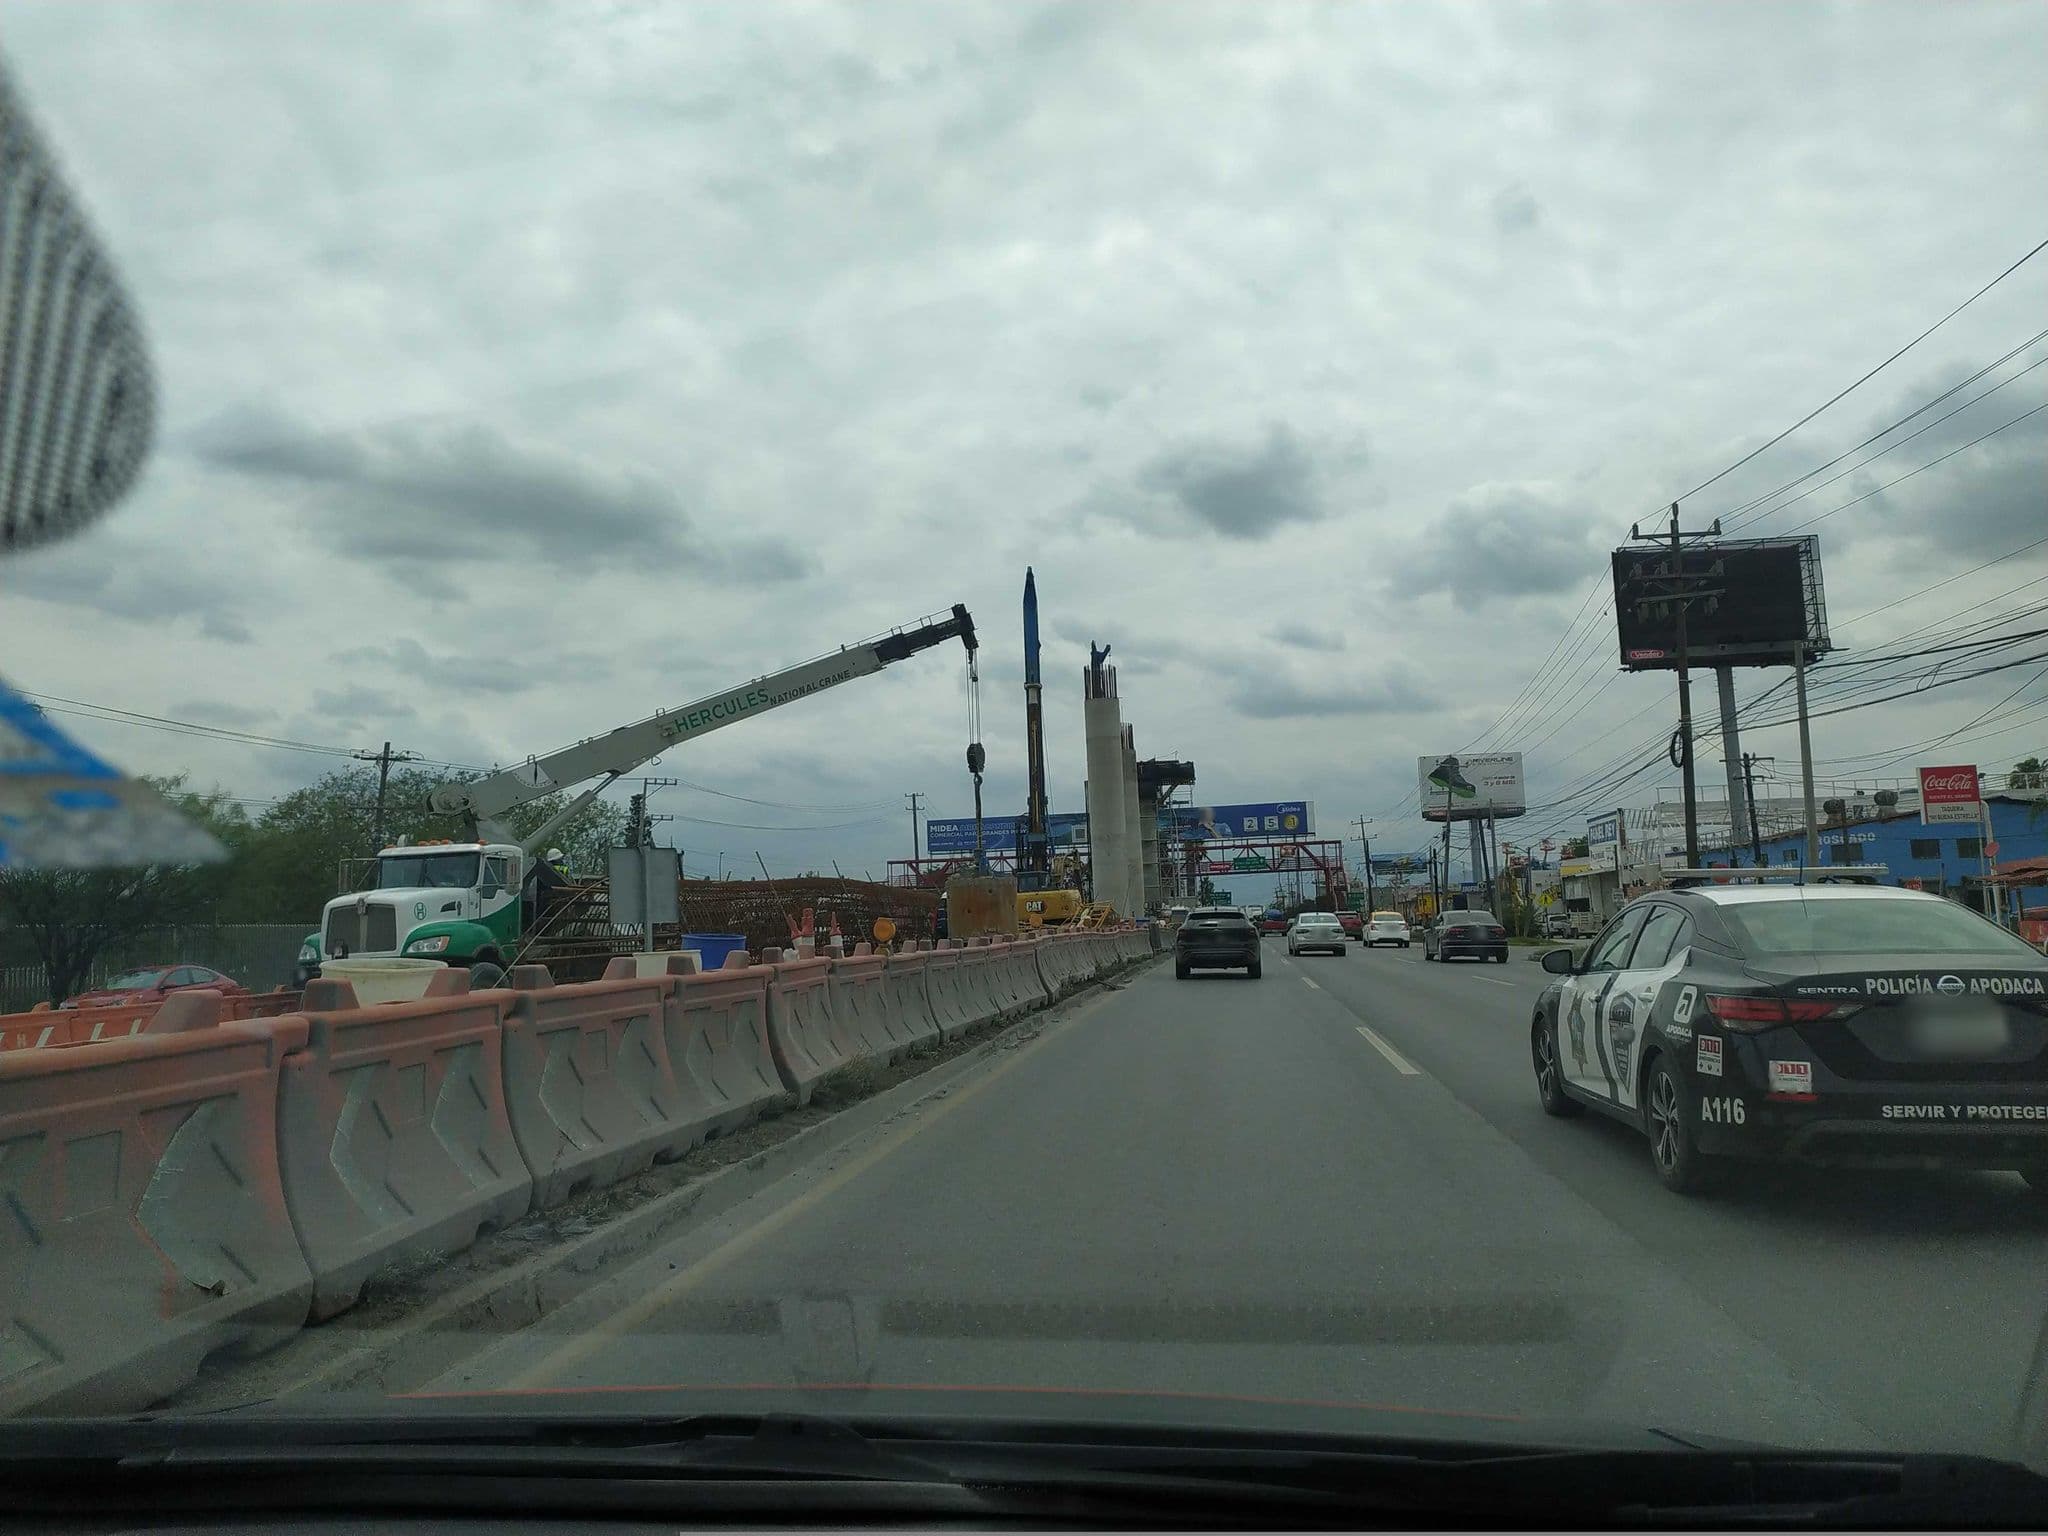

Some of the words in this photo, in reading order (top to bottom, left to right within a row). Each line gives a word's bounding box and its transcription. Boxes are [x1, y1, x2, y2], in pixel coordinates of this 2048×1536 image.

[675, 688, 769, 733] HERCULES
[770, 683, 818, 706] NATIONAL
[819, 670, 850, 688] CRANE
[930, 824, 959, 833] MIDEA
[1247, 819, 1255, 829] 2
[1268, 818, 1275, 828] 5
[1026, 901, 1042, 912] CAT
[1797, 986, 1860, 995] SENTRA
[1865, 974, 1935, 995] POLICÍA
[1970, 977, 2045, 995] APODACA
[1666, 1024, 1693, 1038] APODACA
[1700, 1040, 1720, 1054] 911
[1702, 1097, 1746, 1125] A116
[1882, 1105, 1946, 1119] SERVIR
[1949, 1105, 1963, 1119] Y
[1967, 1105, 2048, 1120] PROTEGE
